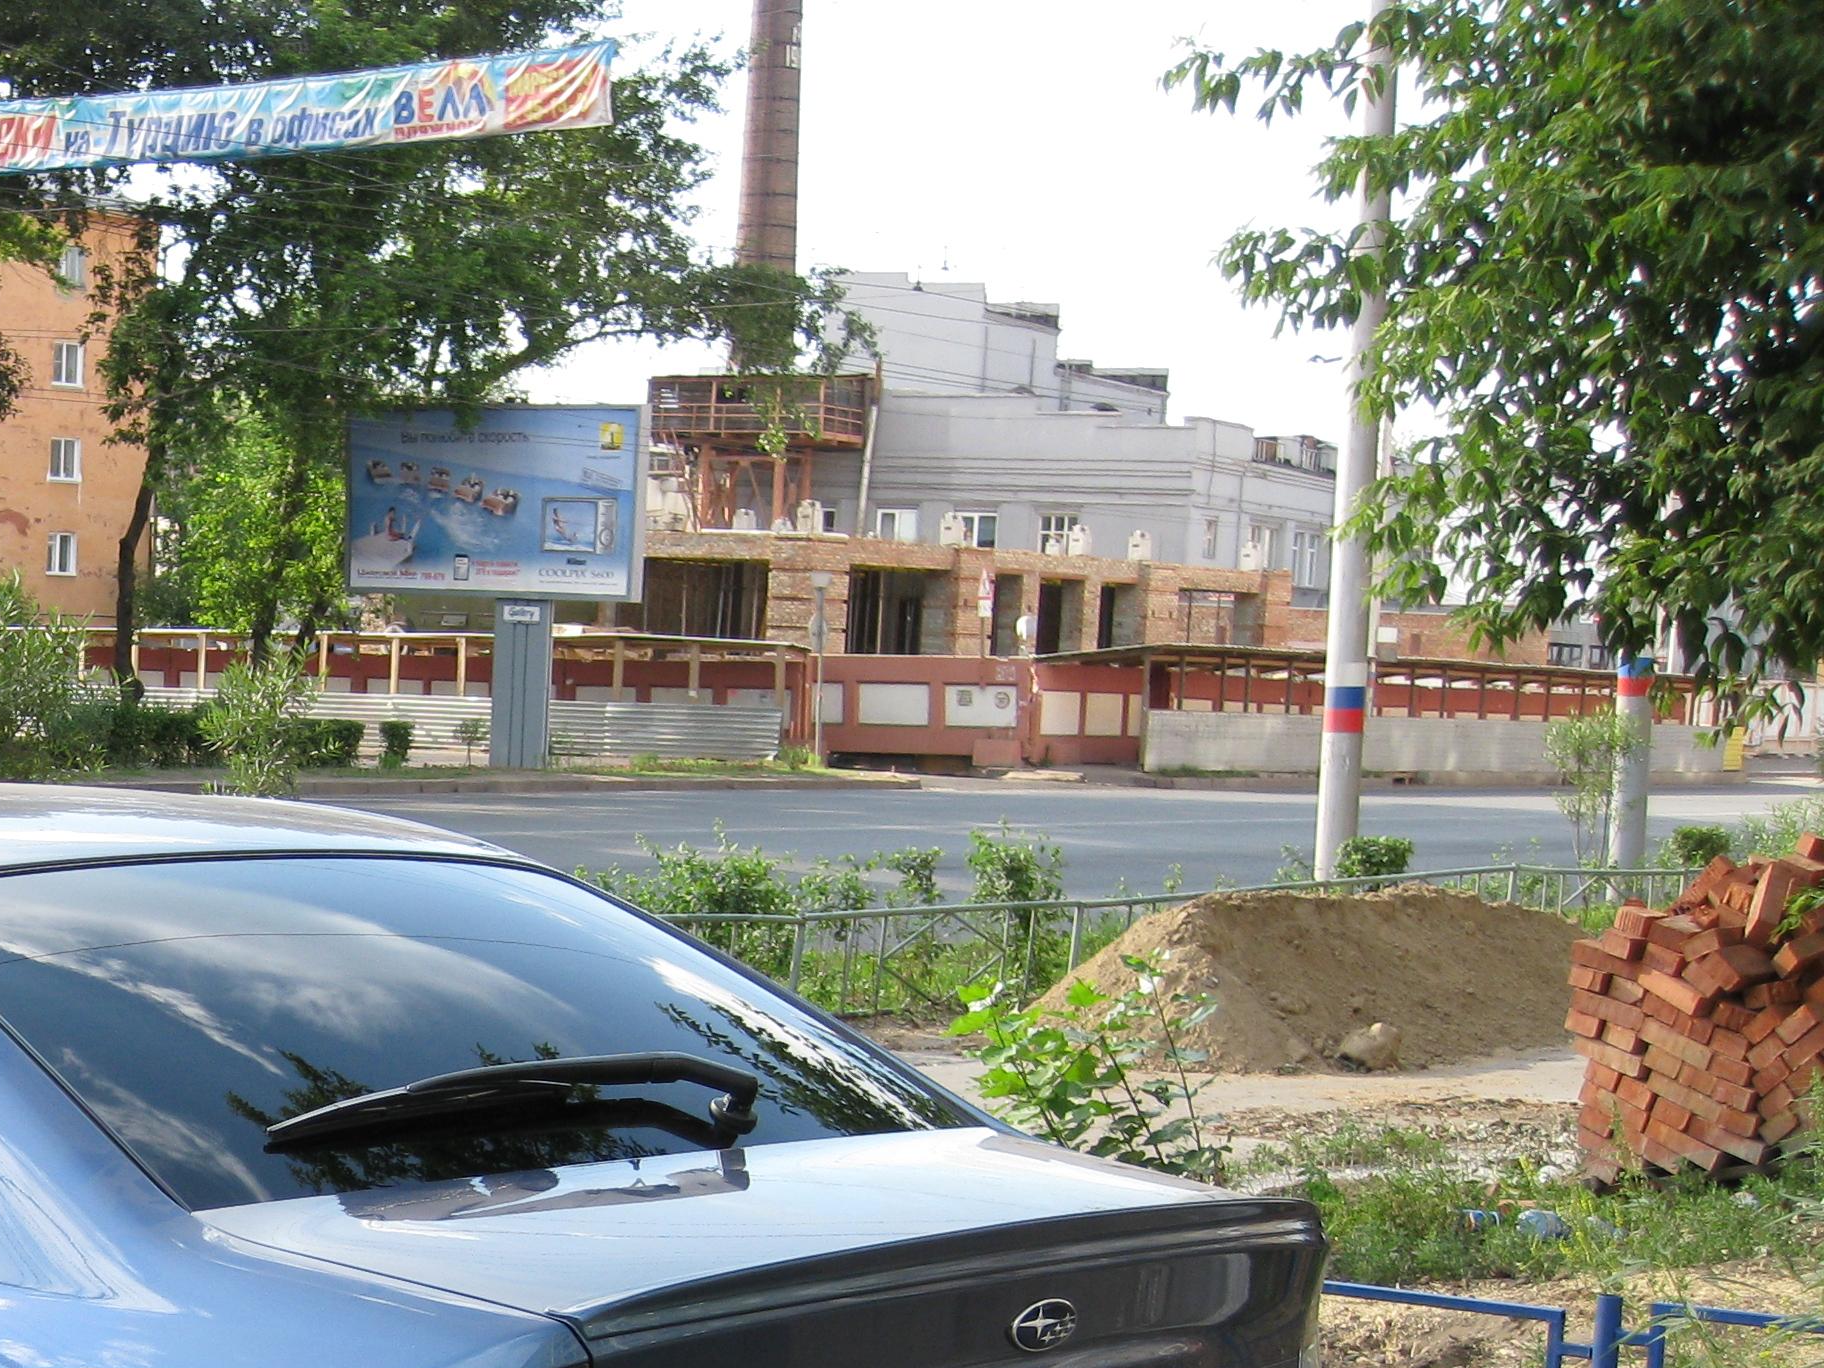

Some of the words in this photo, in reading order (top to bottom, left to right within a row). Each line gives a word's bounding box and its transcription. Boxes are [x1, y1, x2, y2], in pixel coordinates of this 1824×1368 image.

[64, 131, 91, 157] на
[104, 110, 237, 160] Турцию
[245, 118, 264, 147] в
[270, 107, 378, 149] офисах
